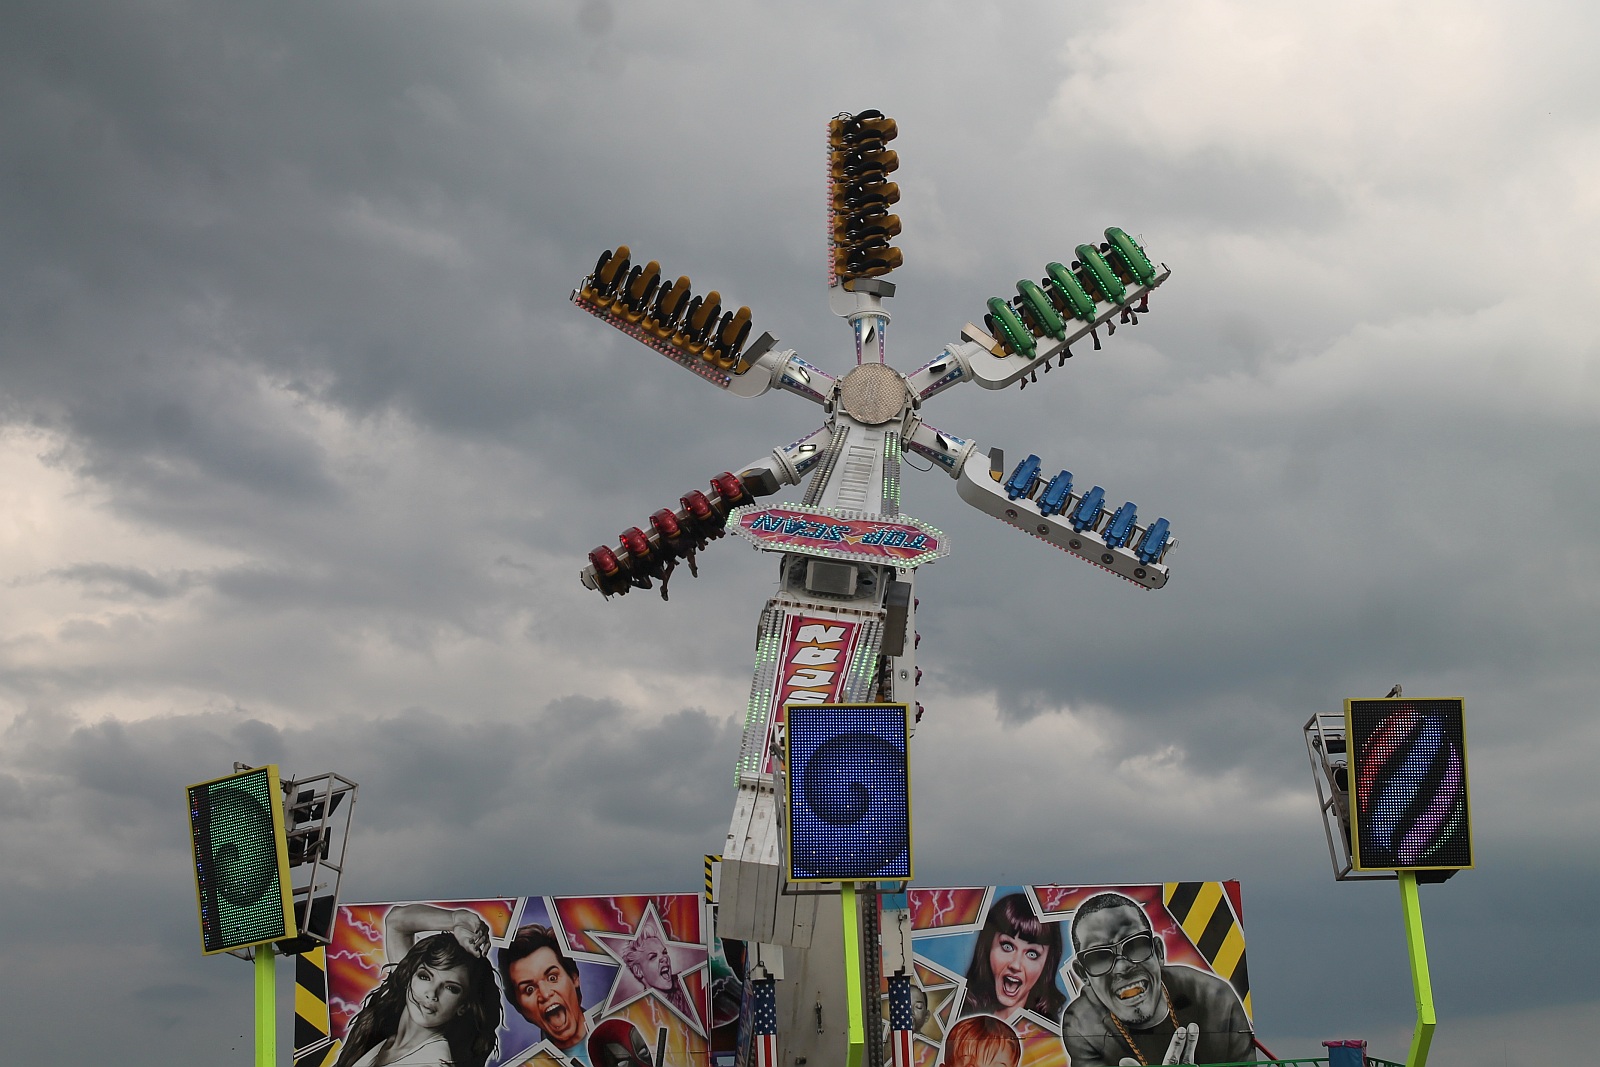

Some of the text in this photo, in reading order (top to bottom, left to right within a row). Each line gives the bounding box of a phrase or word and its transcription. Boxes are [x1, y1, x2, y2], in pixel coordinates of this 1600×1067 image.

[750, 514, 928, 551] TOP SCAN
[782, 623, 846, 706] SCAN
